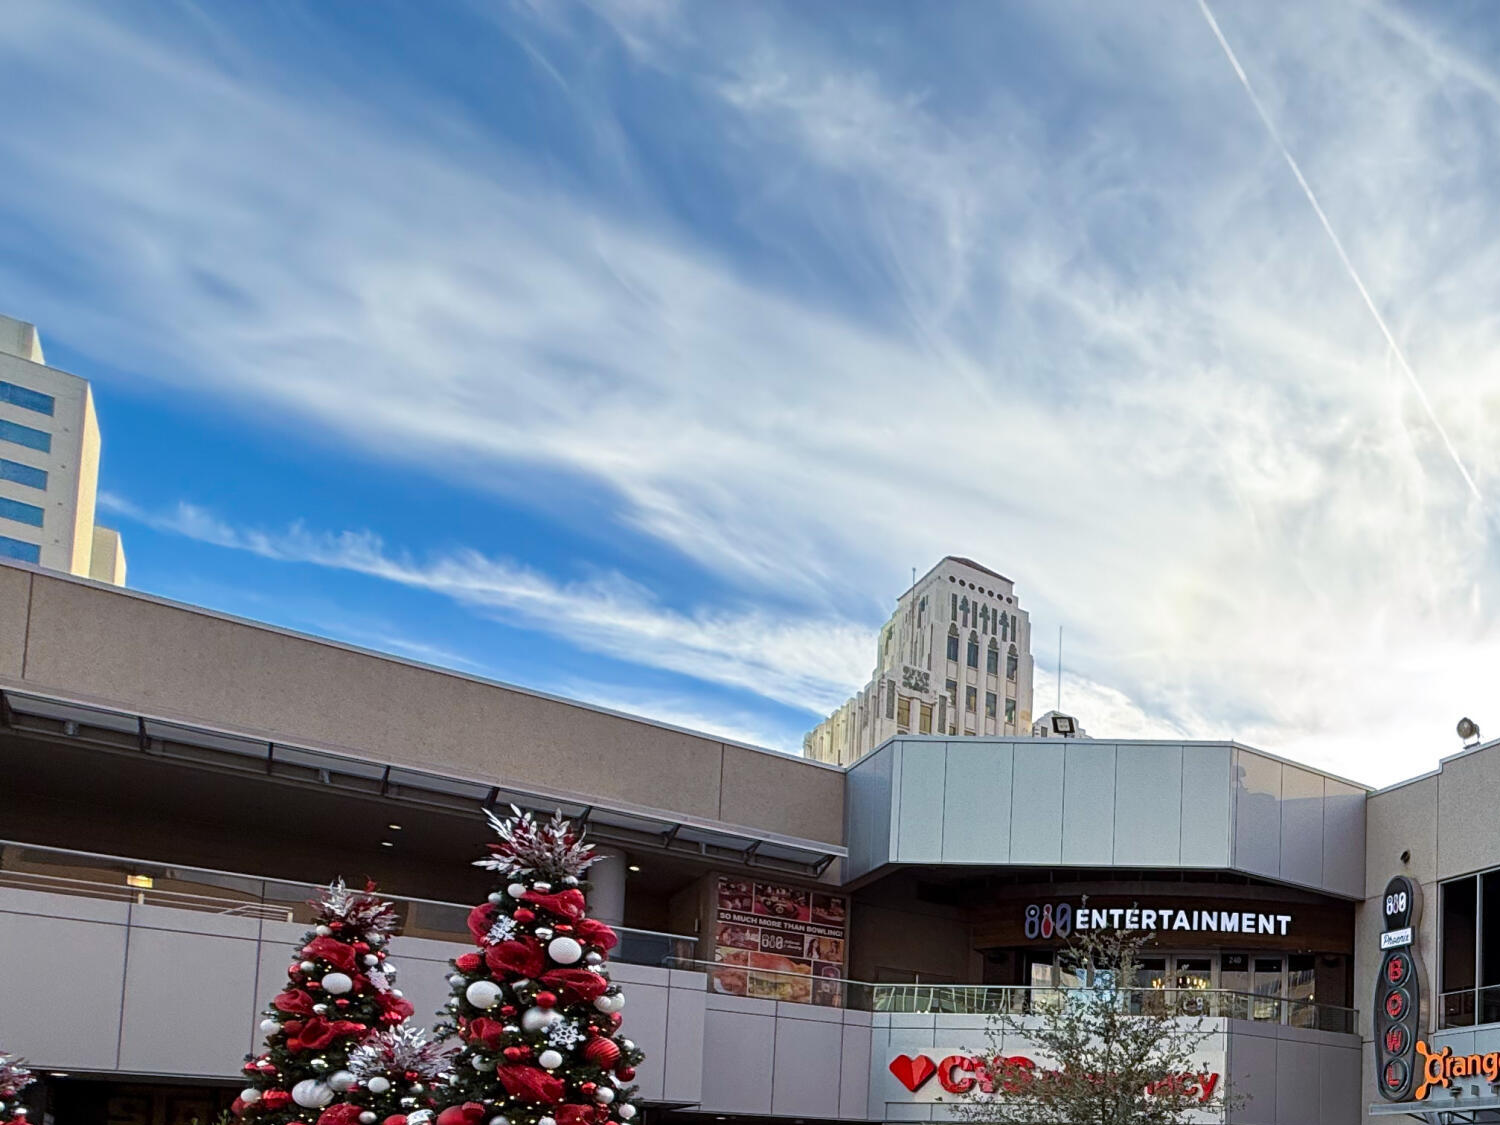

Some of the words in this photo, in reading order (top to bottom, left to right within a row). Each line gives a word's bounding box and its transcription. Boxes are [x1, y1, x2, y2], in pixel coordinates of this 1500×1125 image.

[719, 912, 731, 920] SO
[733, 914, 758, 924] MUCH
[759, 918, 782, 928] MORE
[783, 922, 805, 932] THAN
[806, 926, 843, 938] BOWLING!
[1075, 908, 1291, 936] ENTERTAINMENT
[1386, 959, 1403, 1087] BOWL
